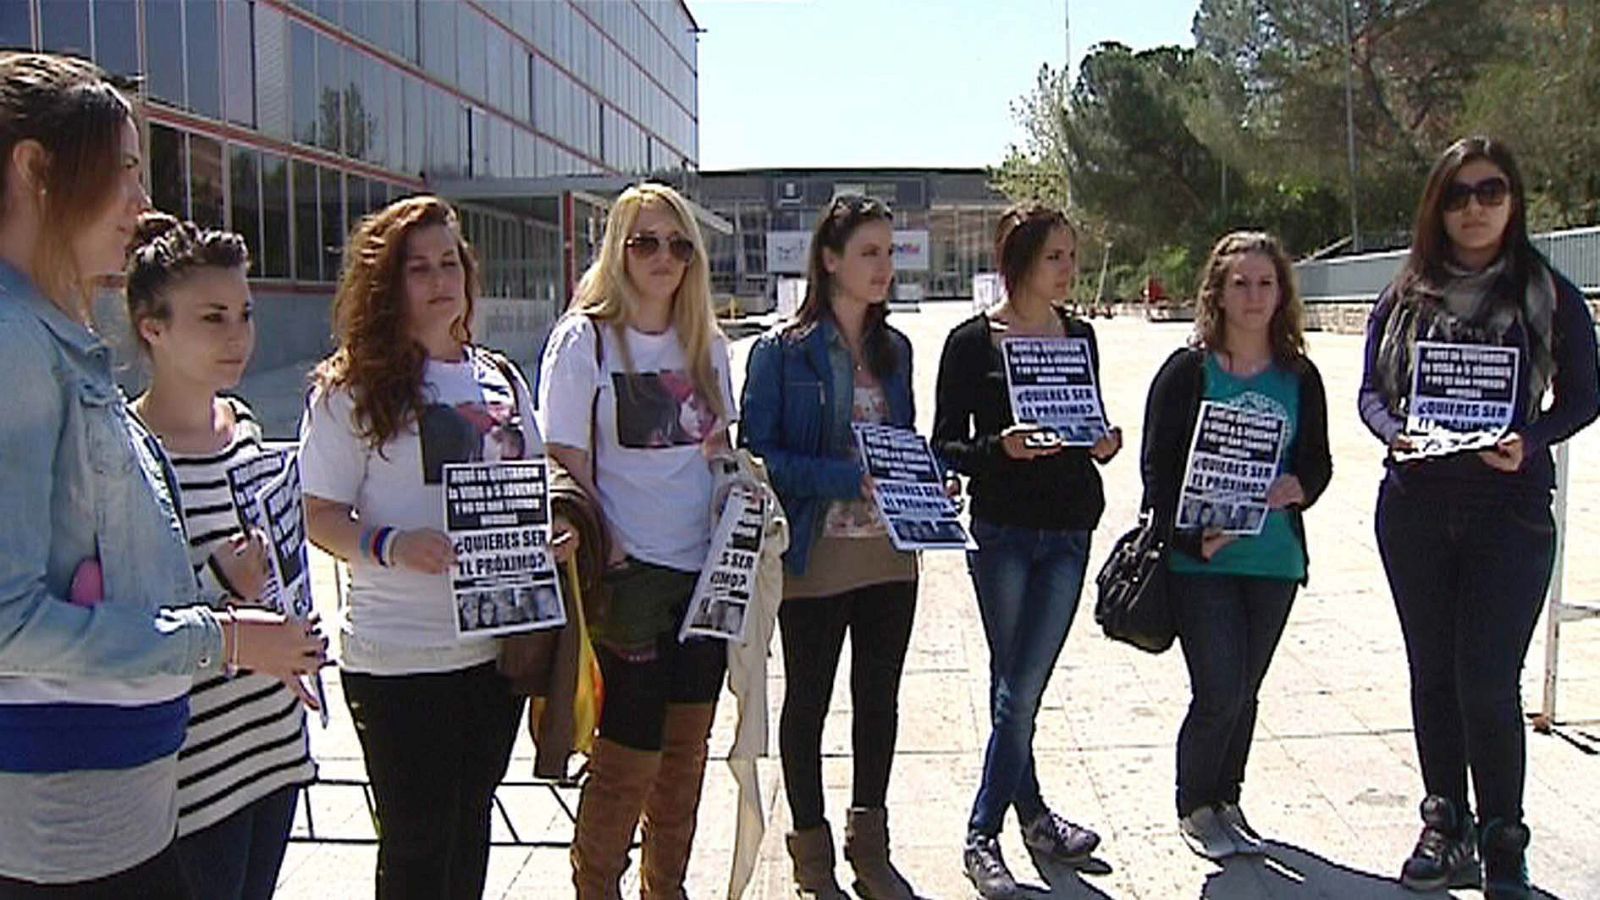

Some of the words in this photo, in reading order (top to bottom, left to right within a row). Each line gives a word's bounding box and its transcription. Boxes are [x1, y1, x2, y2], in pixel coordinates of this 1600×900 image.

[1071, 388, 1093, 400] SER
[1482, 404, 1507, 418] SER
[1249, 464, 1273, 478] SER
[493, 484, 502, 498] 5
[454, 533, 519, 555] ¿QUIERES
[522, 530, 547, 548] SER
[458, 557, 474, 576] EL
[476, 552, 546, 575] PRÓXIMO?
[731, 552, 754, 569] SER
